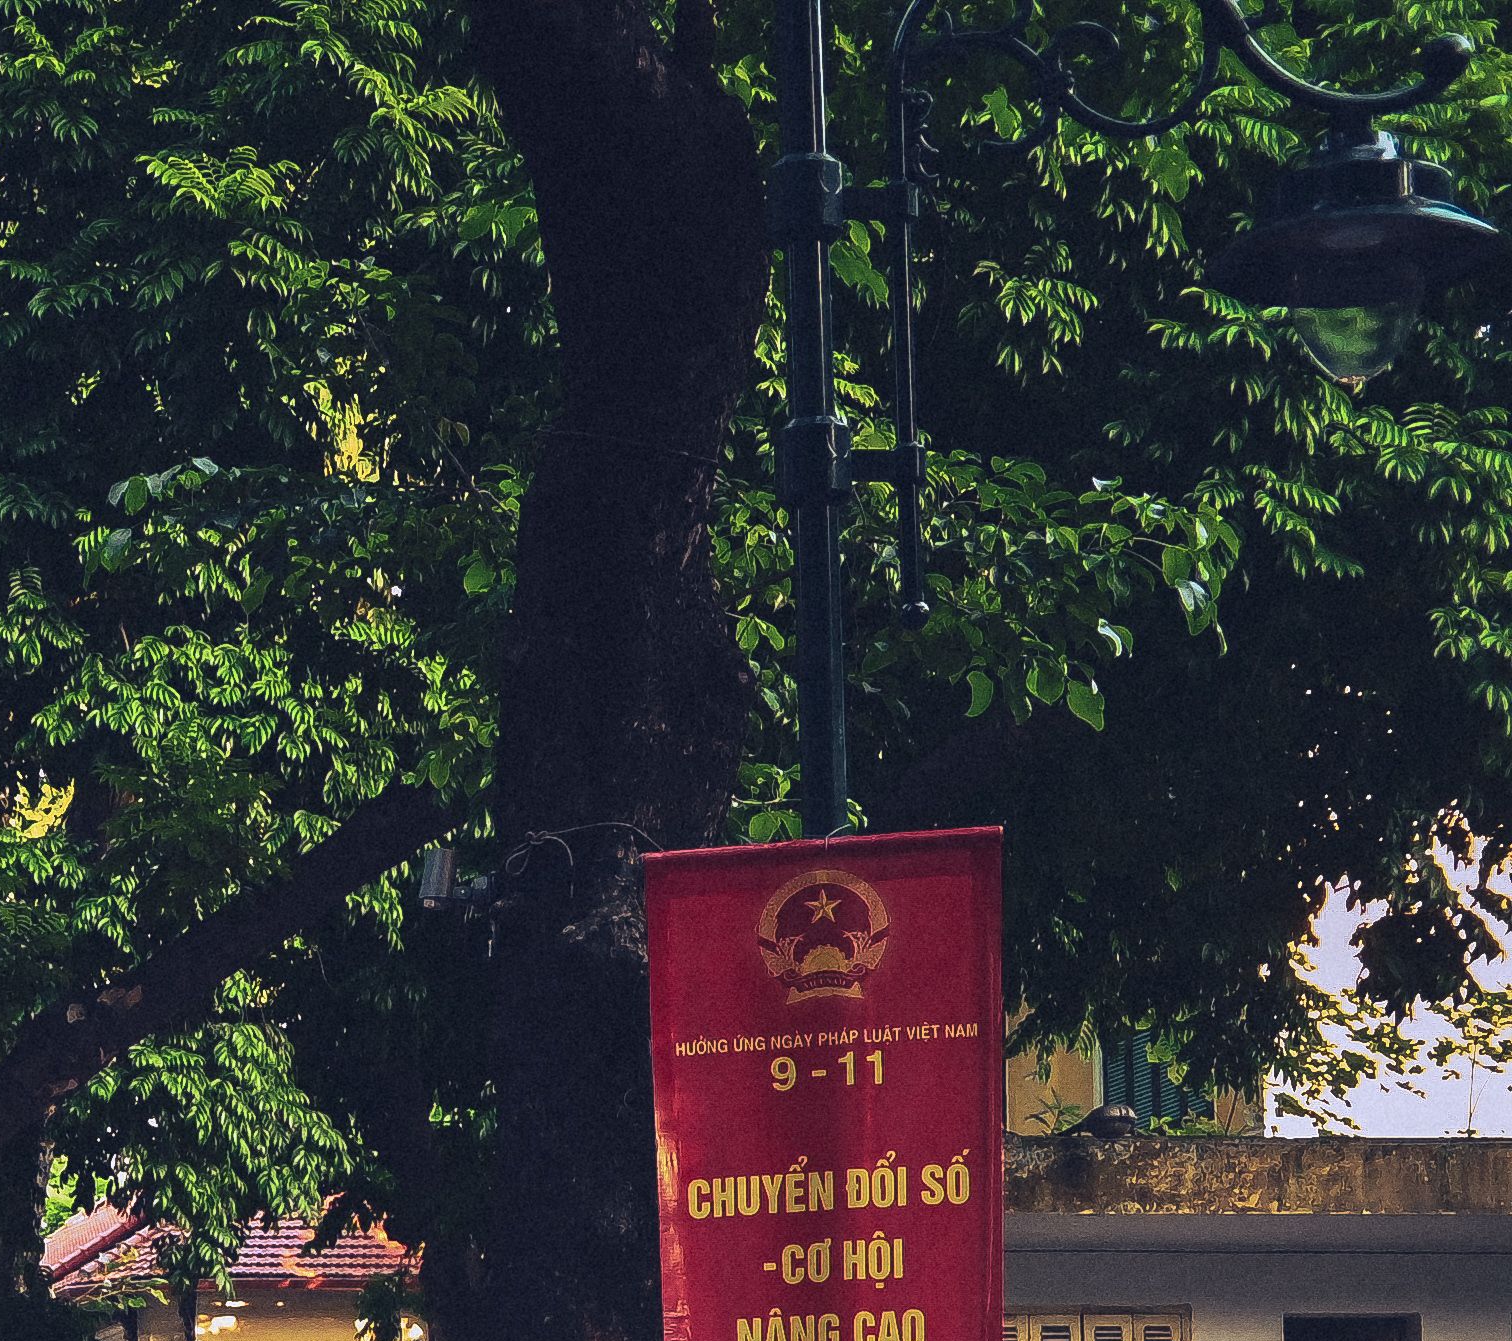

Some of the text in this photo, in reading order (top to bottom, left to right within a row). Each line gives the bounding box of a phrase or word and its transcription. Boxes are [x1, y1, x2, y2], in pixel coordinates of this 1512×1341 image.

[733, 1034, 766, 1052] ỨNG
[770, 1030, 814, 1050] NGÀY
[818, 1027, 859, 1047] PHÁP
[864, 1024, 902, 1046] LUẬT
[906, 1021, 940, 1042] VIỆT
[944, 1022, 979, 1039] NAM
[687, 1148, 970, 1220] CHUYỂN ĐỔI SỐ
[843, 1230, 904, 1289] HỘI
